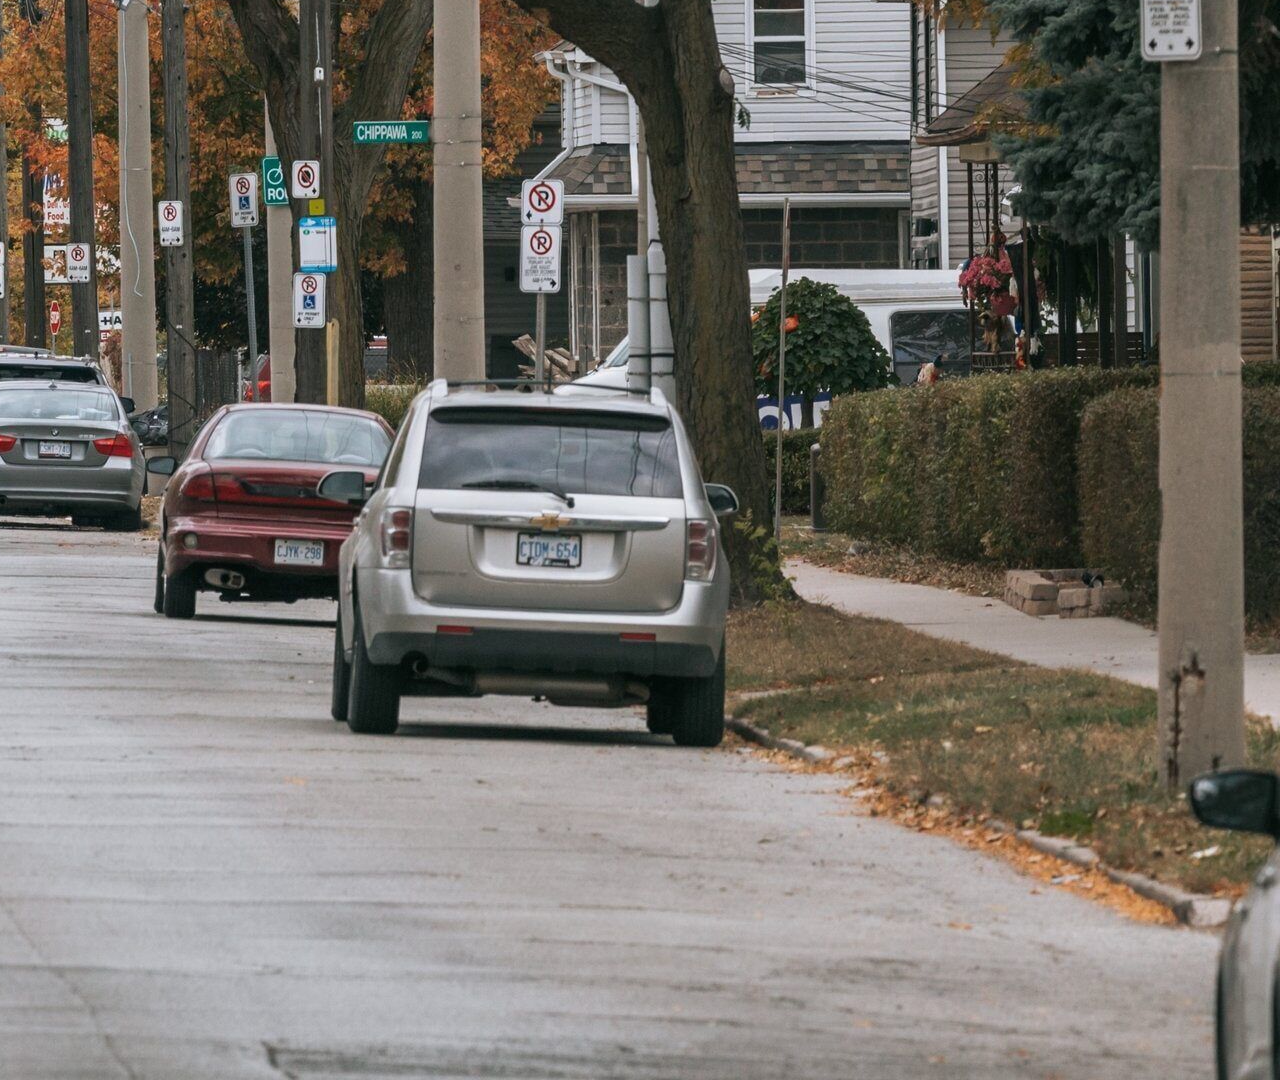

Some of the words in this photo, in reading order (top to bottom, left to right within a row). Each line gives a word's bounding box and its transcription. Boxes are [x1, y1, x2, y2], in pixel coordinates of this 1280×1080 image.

[357, 125, 407, 139] CHIPPAWA
[411, 131, 422, 139] 200
[47, 212, 64, 220] Food
